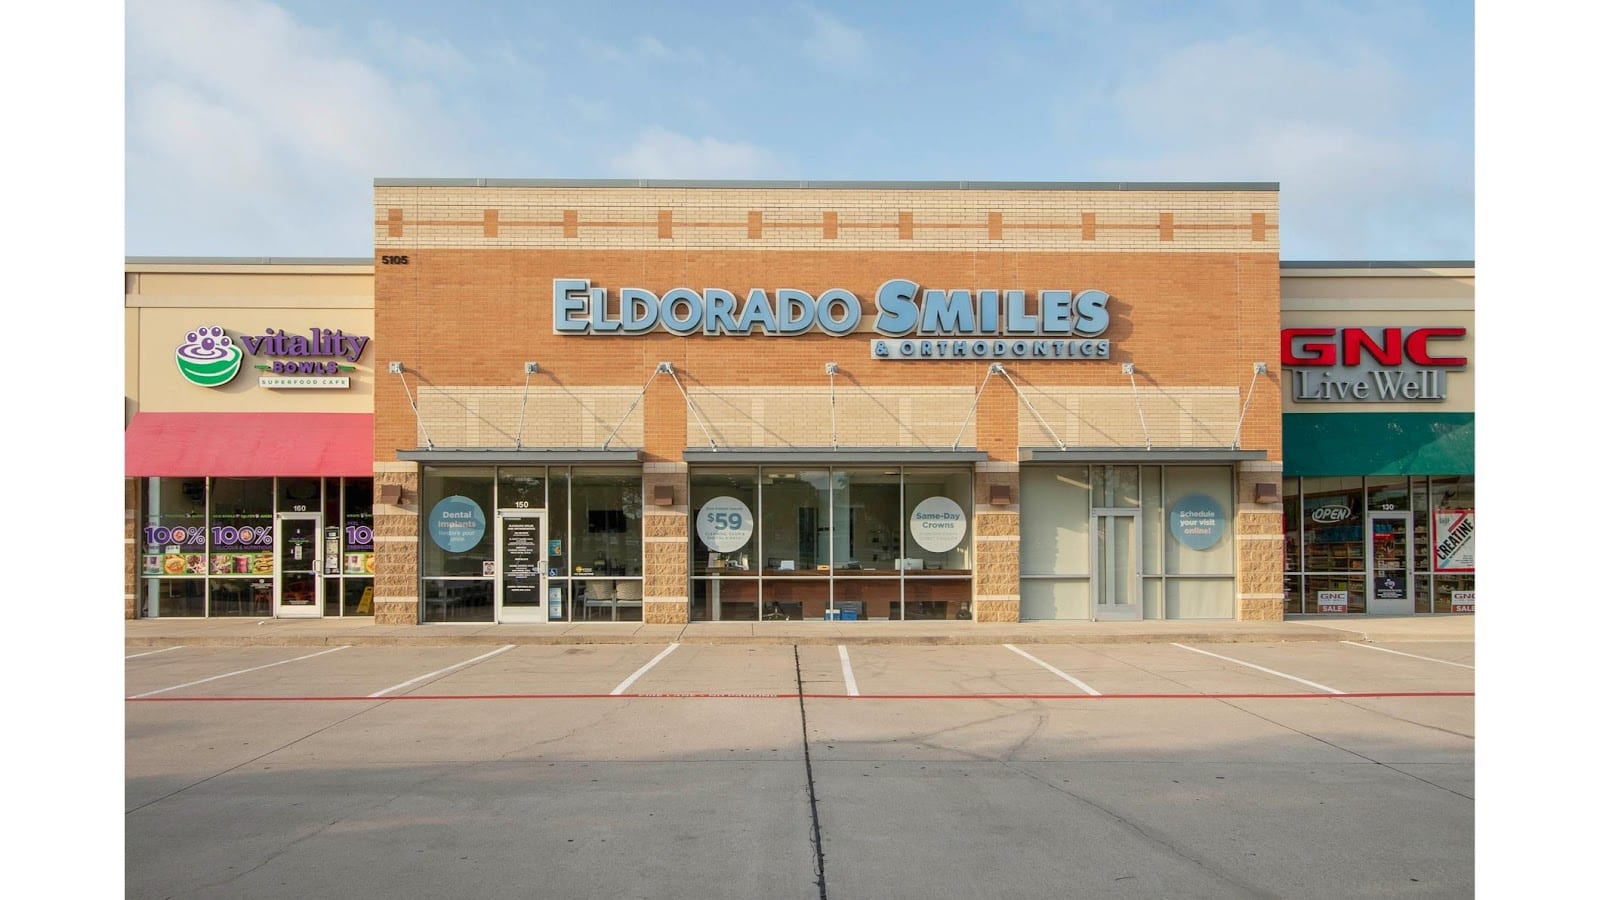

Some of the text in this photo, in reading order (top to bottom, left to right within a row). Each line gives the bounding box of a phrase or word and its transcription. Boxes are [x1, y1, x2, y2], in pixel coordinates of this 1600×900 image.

[381, 255, 408, 265] 5105
[553, 279, 1110, 338] ELDORADO SMILES
[240, 328, 370, 362] vitality
[875, 340, 1109, 357] & ORTHODONTICS
[1280, 328, 1468, 367] GNC
[272, 361, 339, 374] BOWLS
[443, 511, 472, 519] Dental
[707, 512, 743, 530] $59
[916, 512, 960, 520] Same-Day
[1180, 510, 1215, 518] Schedule
[1315, 508, 1347, 520] OPEN
[438, 521, 477, 529] Implants
[922, 521, 954, 529] Crowns
[1180, 519, 1197, 527] your
[144, 526, 206, 545] 100%
[211, 526, 273, 545] 100%
[345, 525, 375, 545] 10
[1436, 518, 1474, 560] CREATINE
